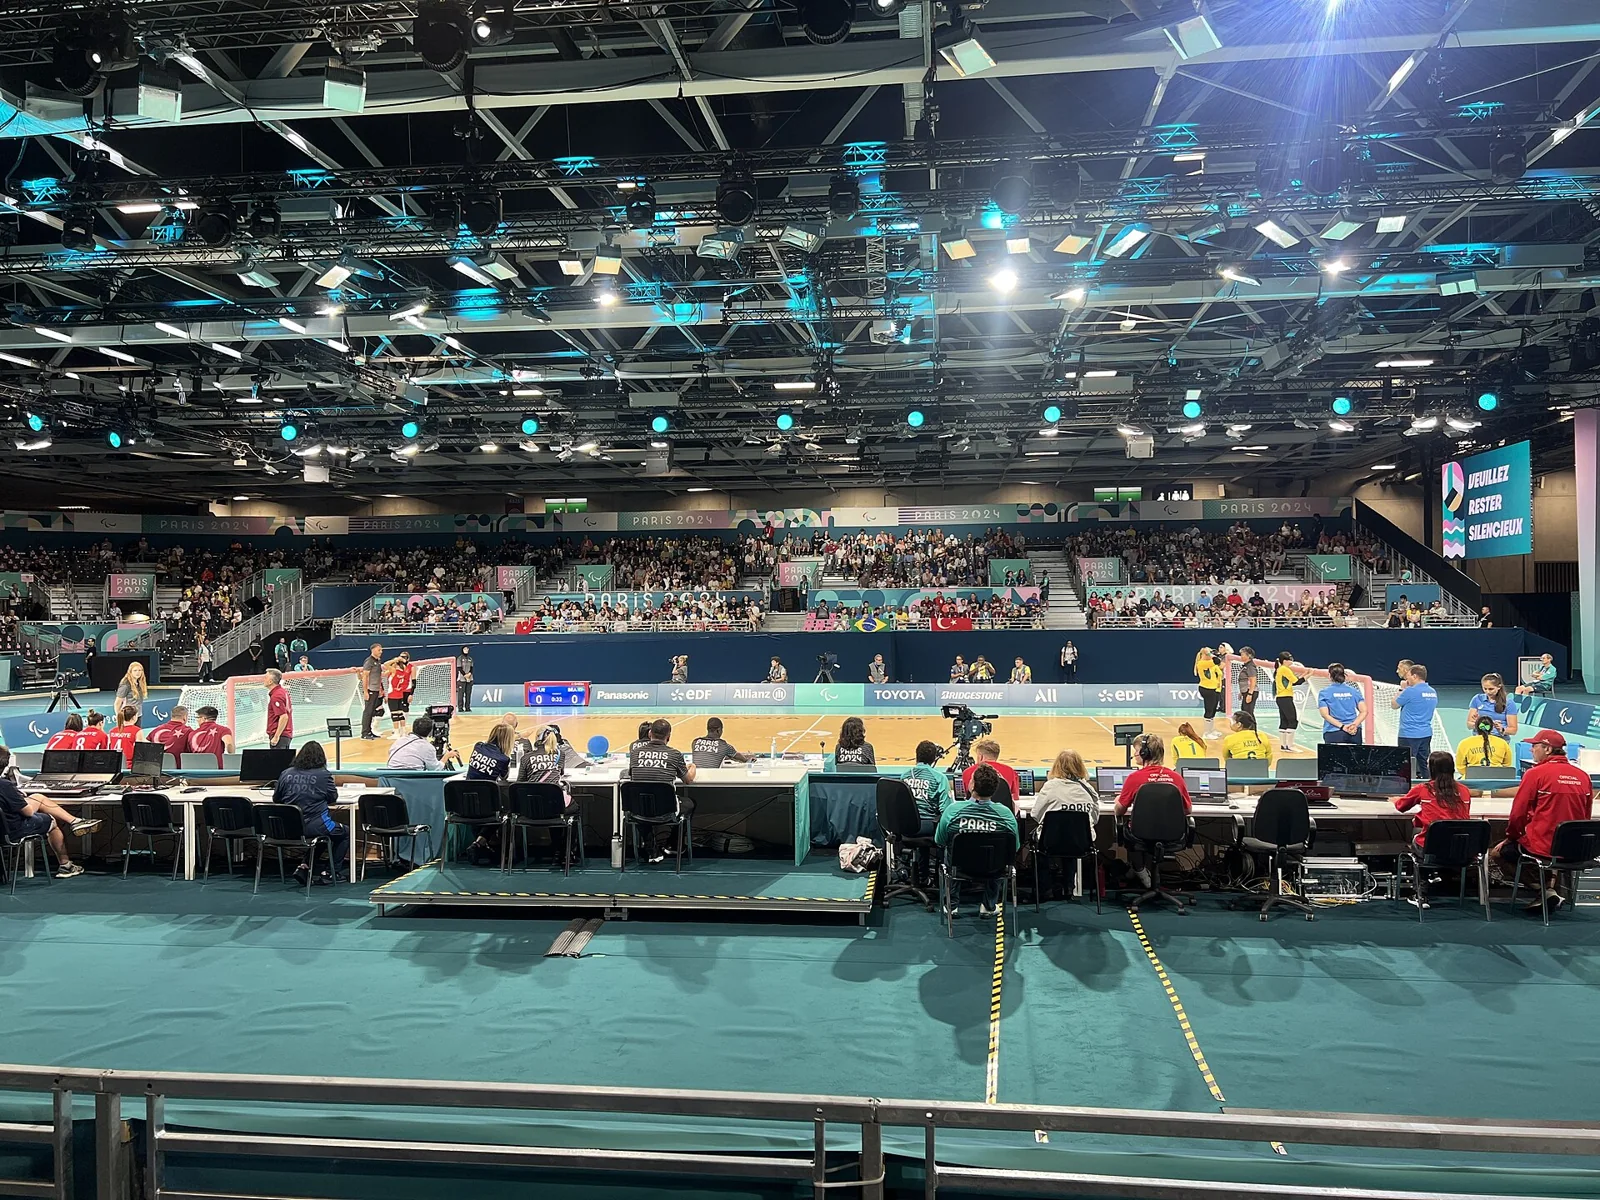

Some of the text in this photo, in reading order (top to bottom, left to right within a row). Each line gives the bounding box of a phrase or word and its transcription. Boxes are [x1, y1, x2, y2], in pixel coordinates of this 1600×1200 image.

[1468, 464, 1510, 490] VEUILLEZ
[1220, 503, 1312, 514] PARIS 2024
[1468, 494, 1502, 515] RESTER
[633, 515, 713, 526] PARIS 2024
[915, 510, 1001, 521] PARIS 2024
[160, 520, 250, 531] PARIS 2024
[363, 519, 440, 529] PARIS 2024
[1468, 517, 1523, 541] SILENCIEUX
[784, 566, 812, 574] PARIS
[1084, 562, 1114, 570] PARIS
[1085, 570, 1114, 579] 024
[116, 578, 148, 586] PARIS
[117, 586, 148, 594] 2024
[597, 690, 649, 700] Panasonic
[733, 688, 771, 699] Allianz
[874, 690, 925, 700] TOYOTA
[940, 690, 1003, 700] BRIDGESTONE
[535, 695, 543, 704] 0
[571, 694, 578, 704] 0
[695, 738, 719, 747] PARIS
[694, 744, 719, 753] 2024
[471, 750, 498, 768] PARIS
[529, 752, 559, 764] PARIS
[638, 751, 669, 760] PARIS
[839, 754, 863, 762] 2024
[469, 757, 494, 775] 2024
[637, 758, 668, 769] 2024
[286, 774, 318, 785] PARIS
[959, 817, 997, 832] PARIS
